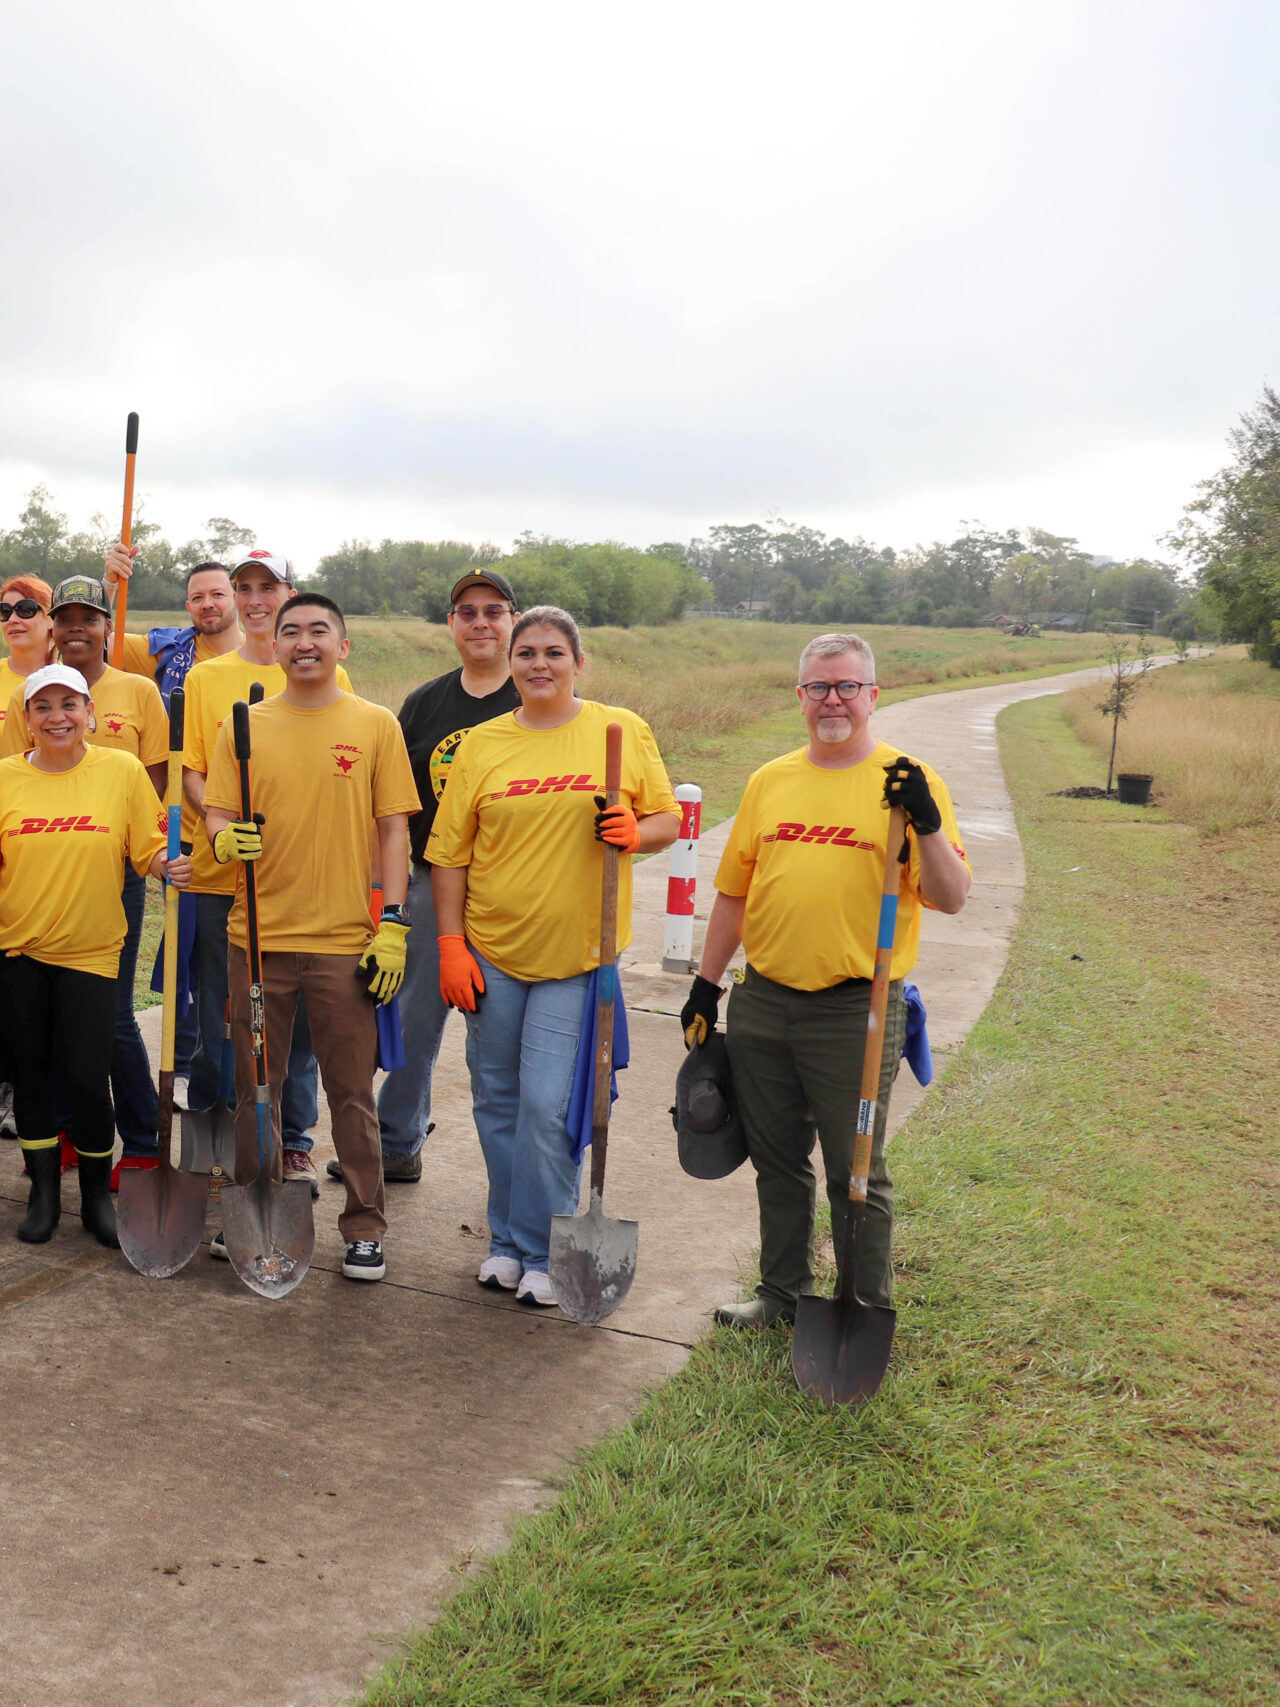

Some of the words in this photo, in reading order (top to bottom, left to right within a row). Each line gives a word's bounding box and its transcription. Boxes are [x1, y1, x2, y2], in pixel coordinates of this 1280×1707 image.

[505, 774, 598, 798] DHL
[19, 815, 98, 835] DHL
[775, 822, 859, 848] DHL
